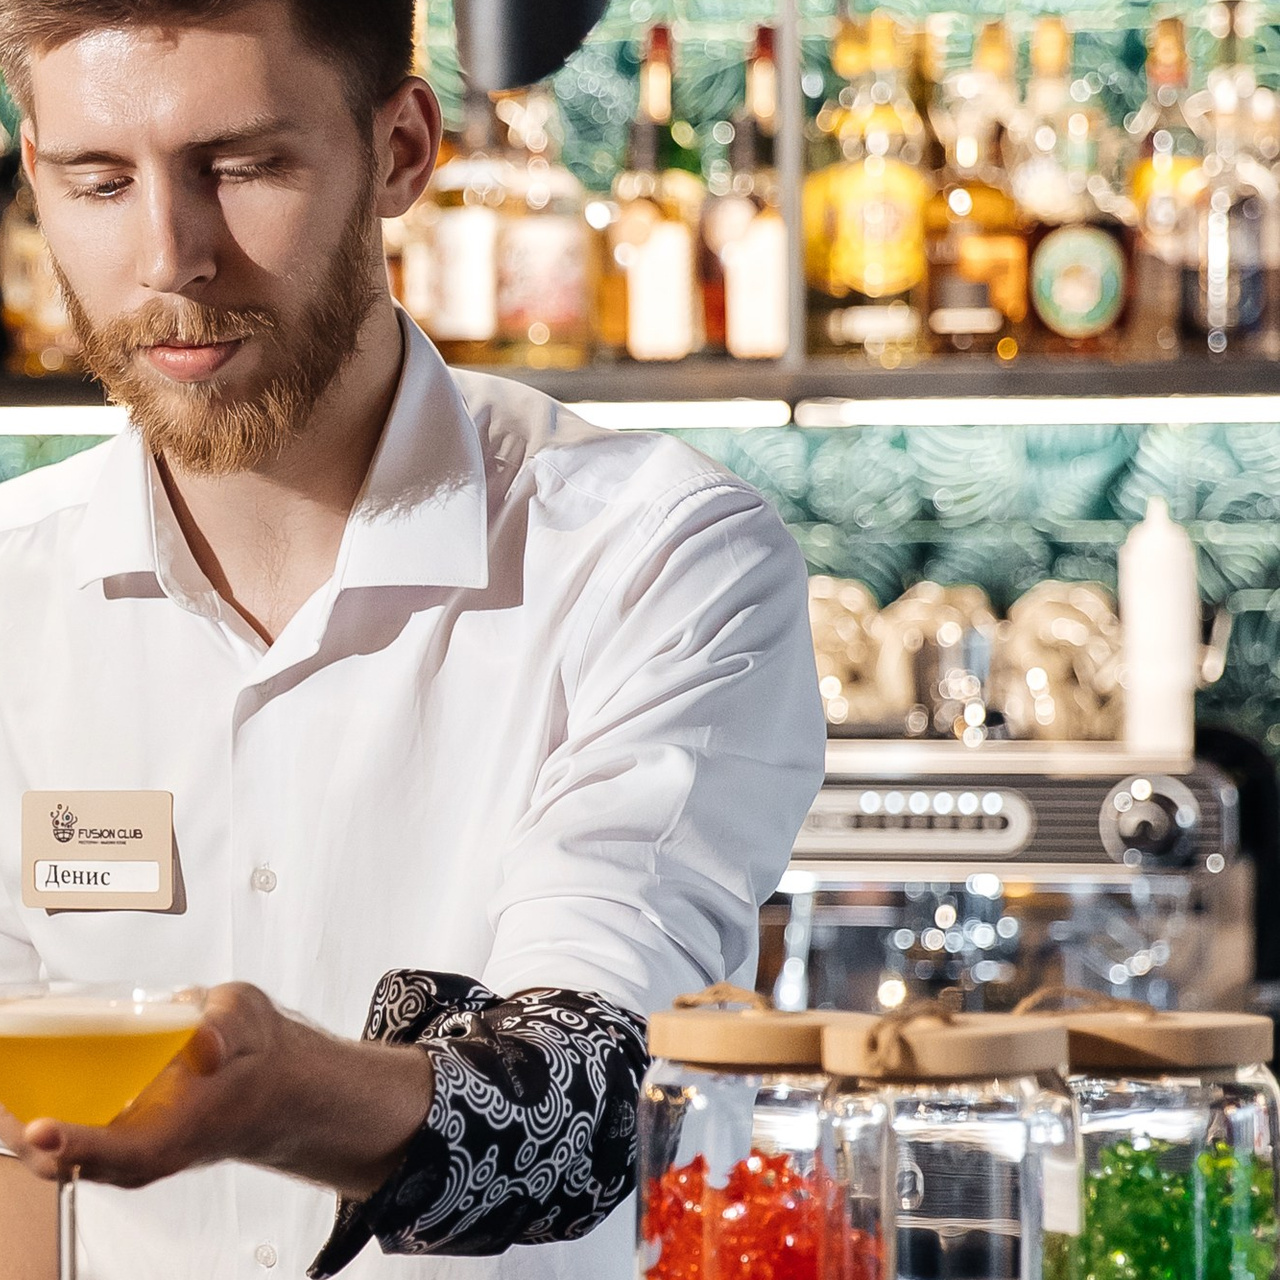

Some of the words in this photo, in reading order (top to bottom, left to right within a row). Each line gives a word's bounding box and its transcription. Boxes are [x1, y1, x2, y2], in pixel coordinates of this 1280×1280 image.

[78, 828, 116, 839] FUSION
[117, 828, 143, 839] CLUB
[45, 864, 111, 888] Денис
